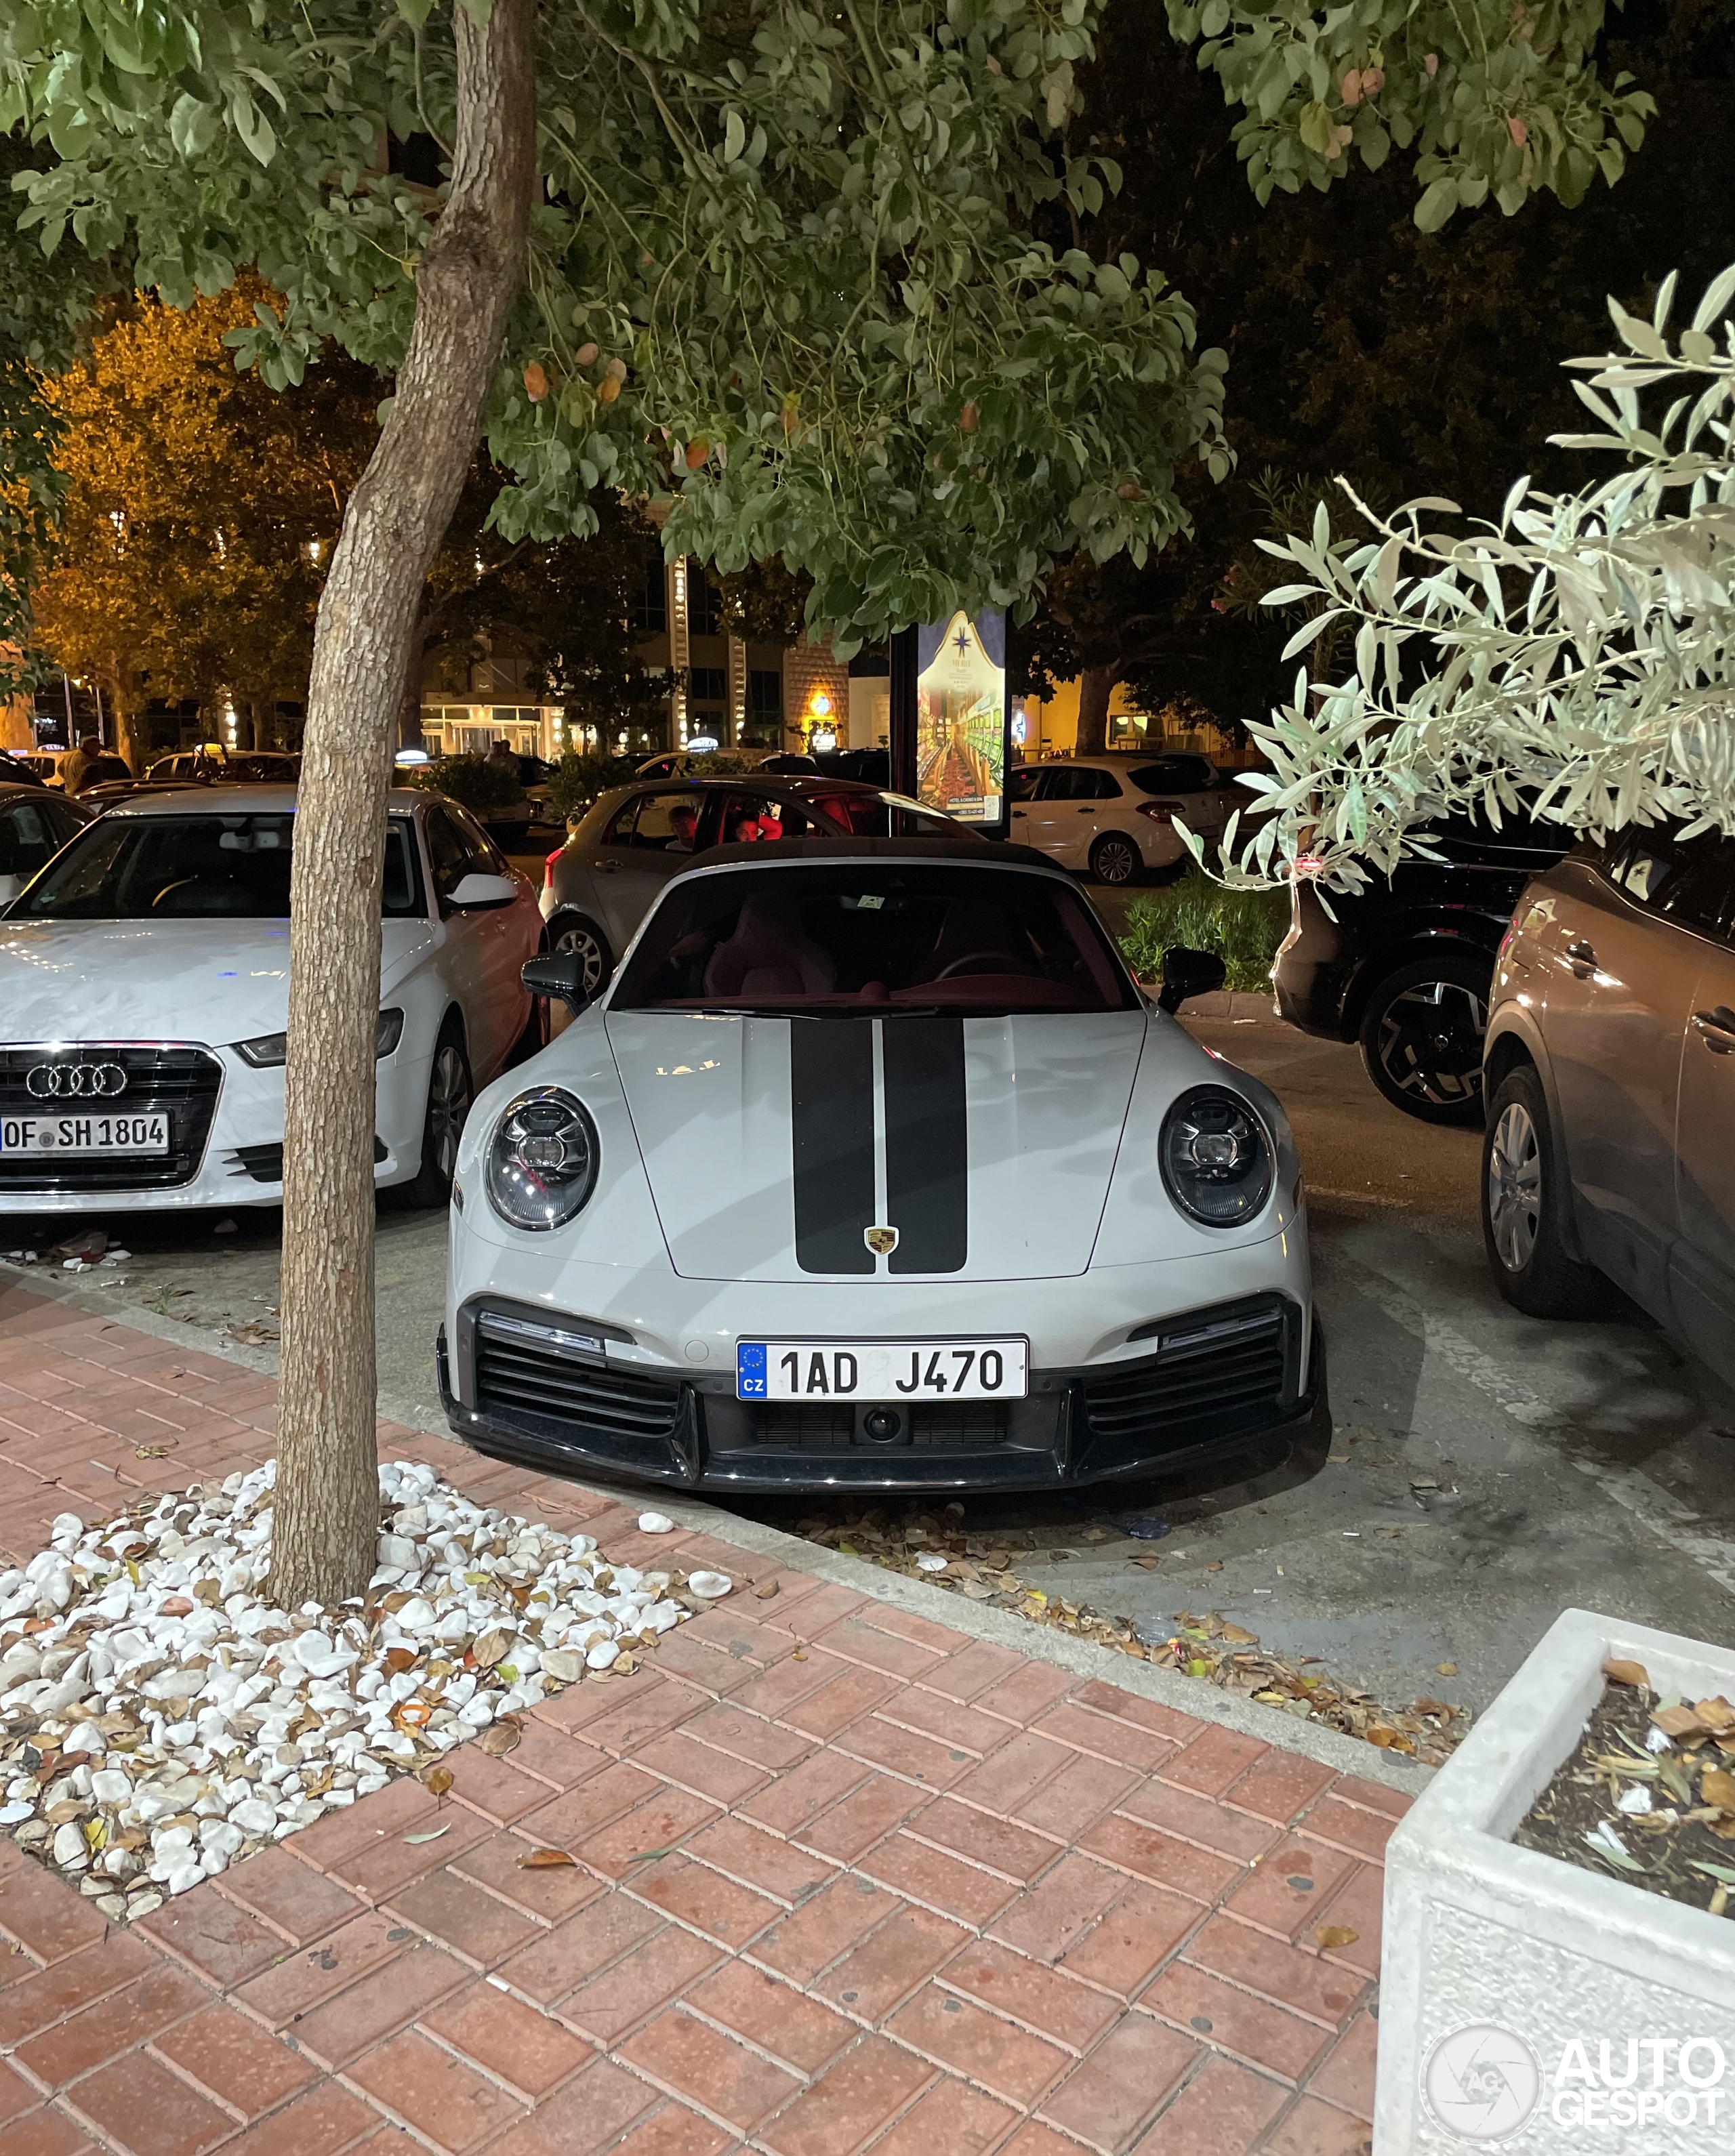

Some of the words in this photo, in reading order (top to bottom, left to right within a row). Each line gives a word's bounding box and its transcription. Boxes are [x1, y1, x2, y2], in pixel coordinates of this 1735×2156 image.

[4, 1121, 37, 1148] OF
[58, 1119, 91, 1146] SH
[98, 1118, 164, 1146] 1804
[743, 1379, 764, 1392] CZ
[781, 1351, 858, 1394] 1AD
[895, 1350, 1004, 1393] J470
